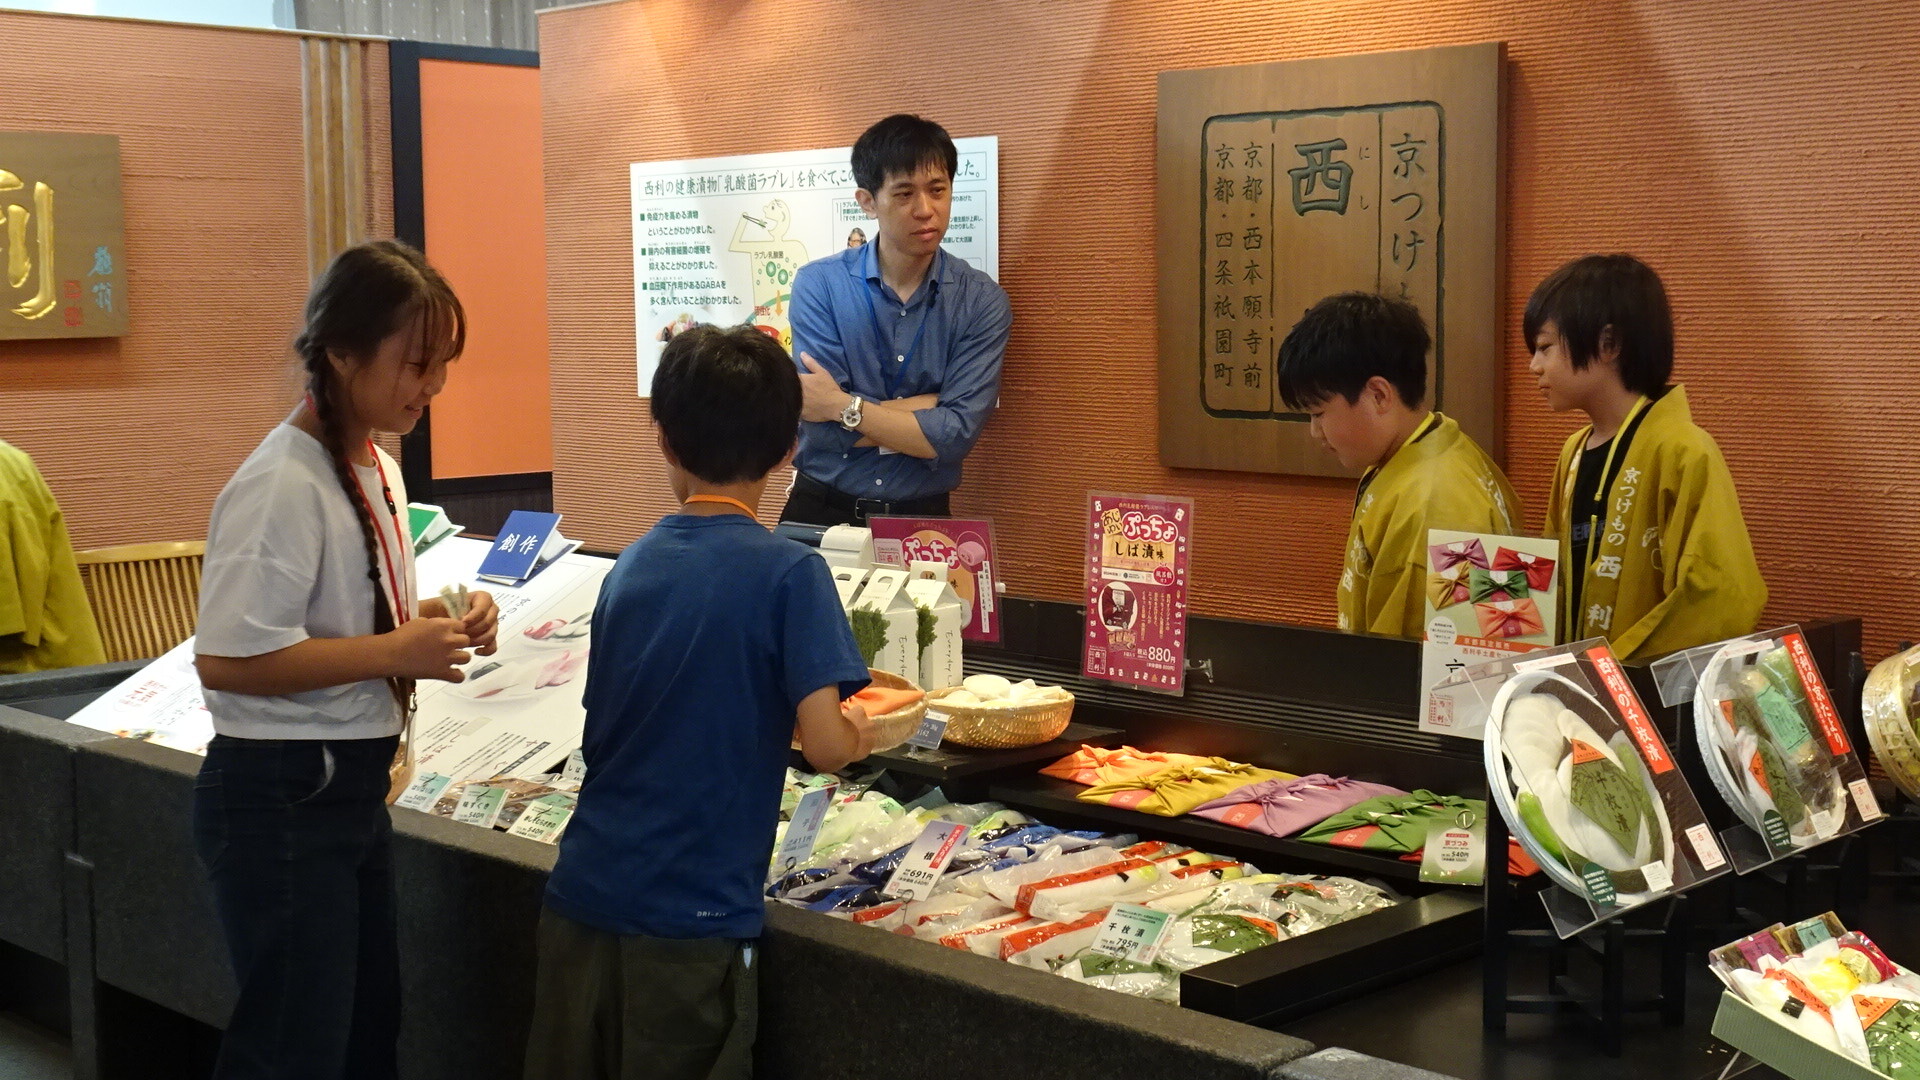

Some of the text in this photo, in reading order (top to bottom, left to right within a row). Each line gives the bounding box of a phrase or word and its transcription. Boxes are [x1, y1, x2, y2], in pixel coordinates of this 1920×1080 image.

[1287, 137, 1354, 217] 西
[1391, 133, 1427, 298] 京つけ
[648, 225, 715, 236] ということがわかりました。
[1213, 143, 1235, 387] 京都・四条祇園町
[1242, 141, 1263, 389] 京都・西本願寺前
[650, 296, 741, 306] 多く含んでいることがわかりました。
[1607, 467, 1641, 546] 京つけもの
[1124, 515, 1175, 540] ぷっちょ
[497, 533, 539, 555] 創作
[904, 538, 959, 567] ぷっちょ
[1148, 646, 1176, 664] 880円
[1596, 657, 1662, 761] 西利の千枚漬
[910, 869, 934, 881] 691円
[1109, 922, 1146, 937] 千枚漬
